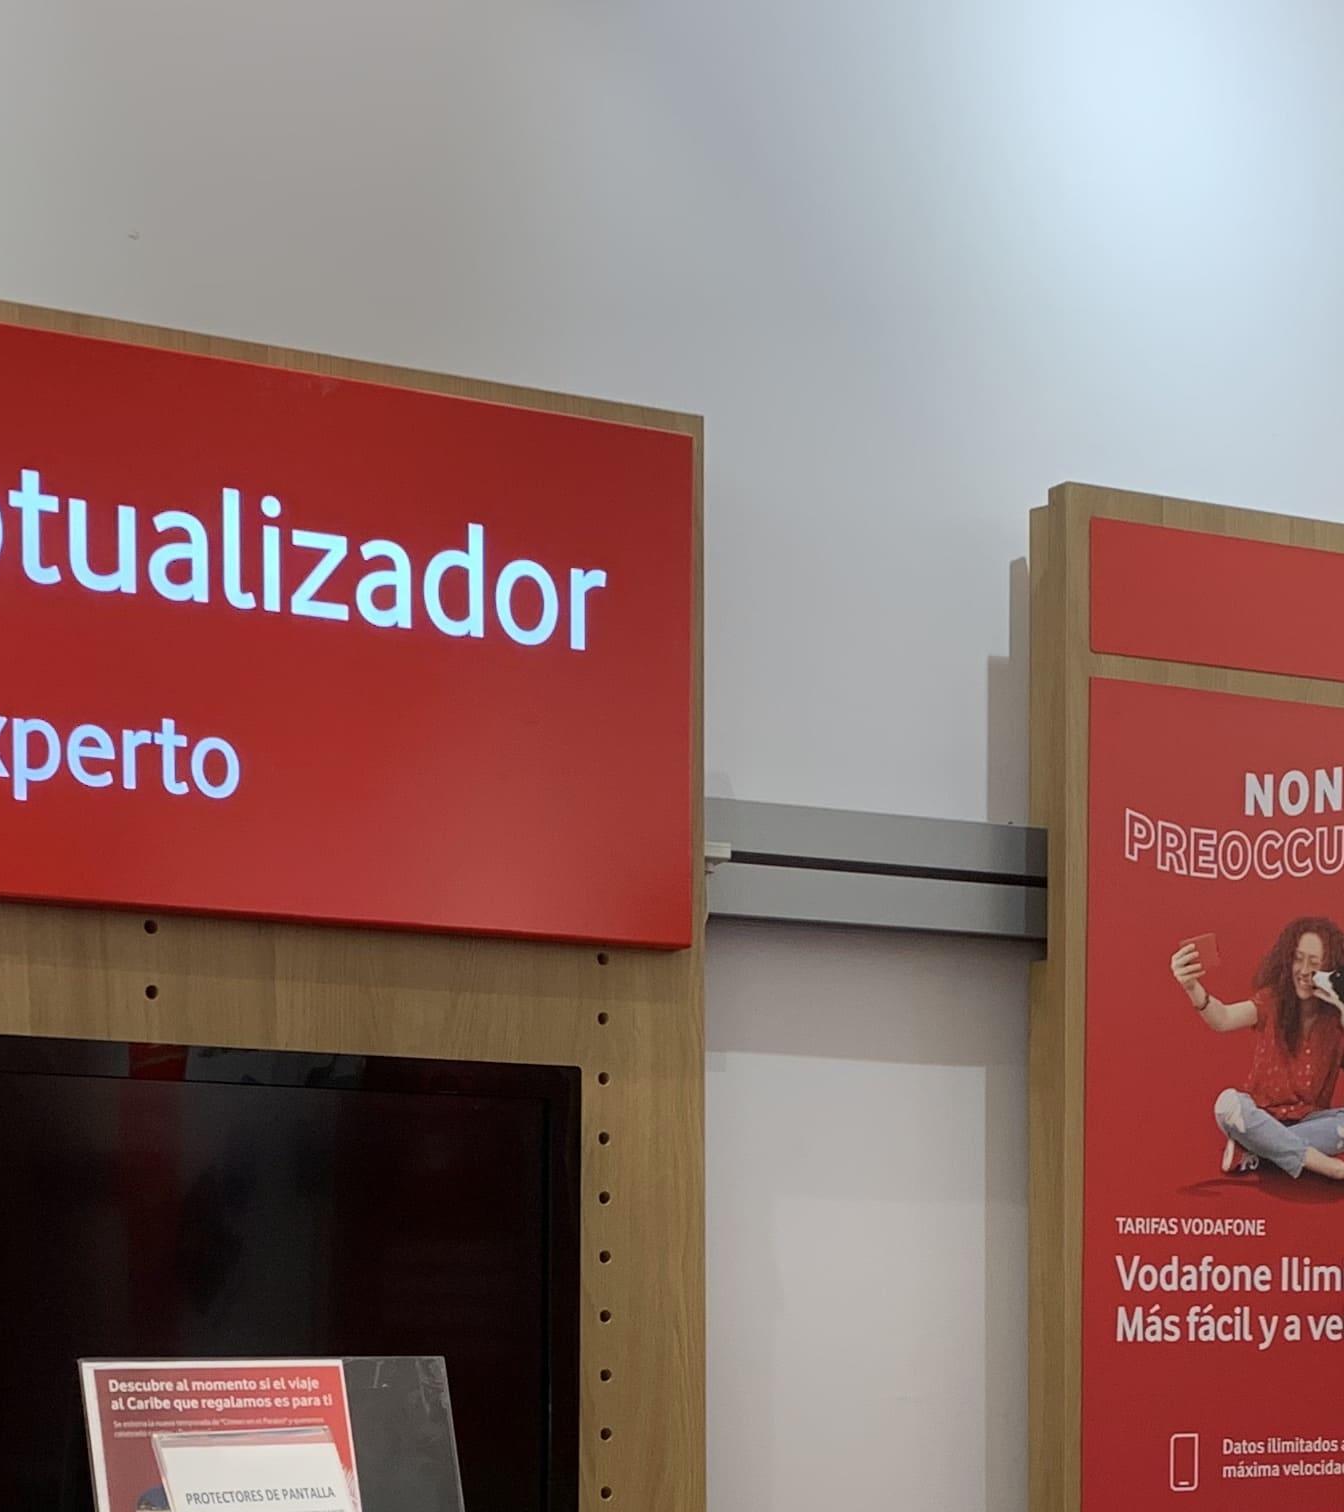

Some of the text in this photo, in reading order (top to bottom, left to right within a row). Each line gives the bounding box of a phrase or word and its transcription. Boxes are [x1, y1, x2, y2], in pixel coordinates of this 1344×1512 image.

[1244, 766, 1344, 817] NON
[1116, 1216, 1266, 1236] TARIFAS VODAFONE
[1115, 1255, 1272, 1292] Vodafone
[1116, 1304, 1181, 1342] Más
[1187, 1304, 1253, 1342] fácil
[1258, 1313, 1279, 1350] y
[1284, 1314, 1302, 1341] a
[108, 1376, 320, 1393] Descubre al momento si el viaje
[111, 1394, 333, 1412] al Caribe que regalamos es para ti
[1222, 1438, 1265, 1456] Datos
[1267, 1436, 1339, 1454] ilimitados
[1222, 1460, 1281, 1479] máxima
[186, 1486, 336, 1504] PROTECTORES DE PANTALLA
